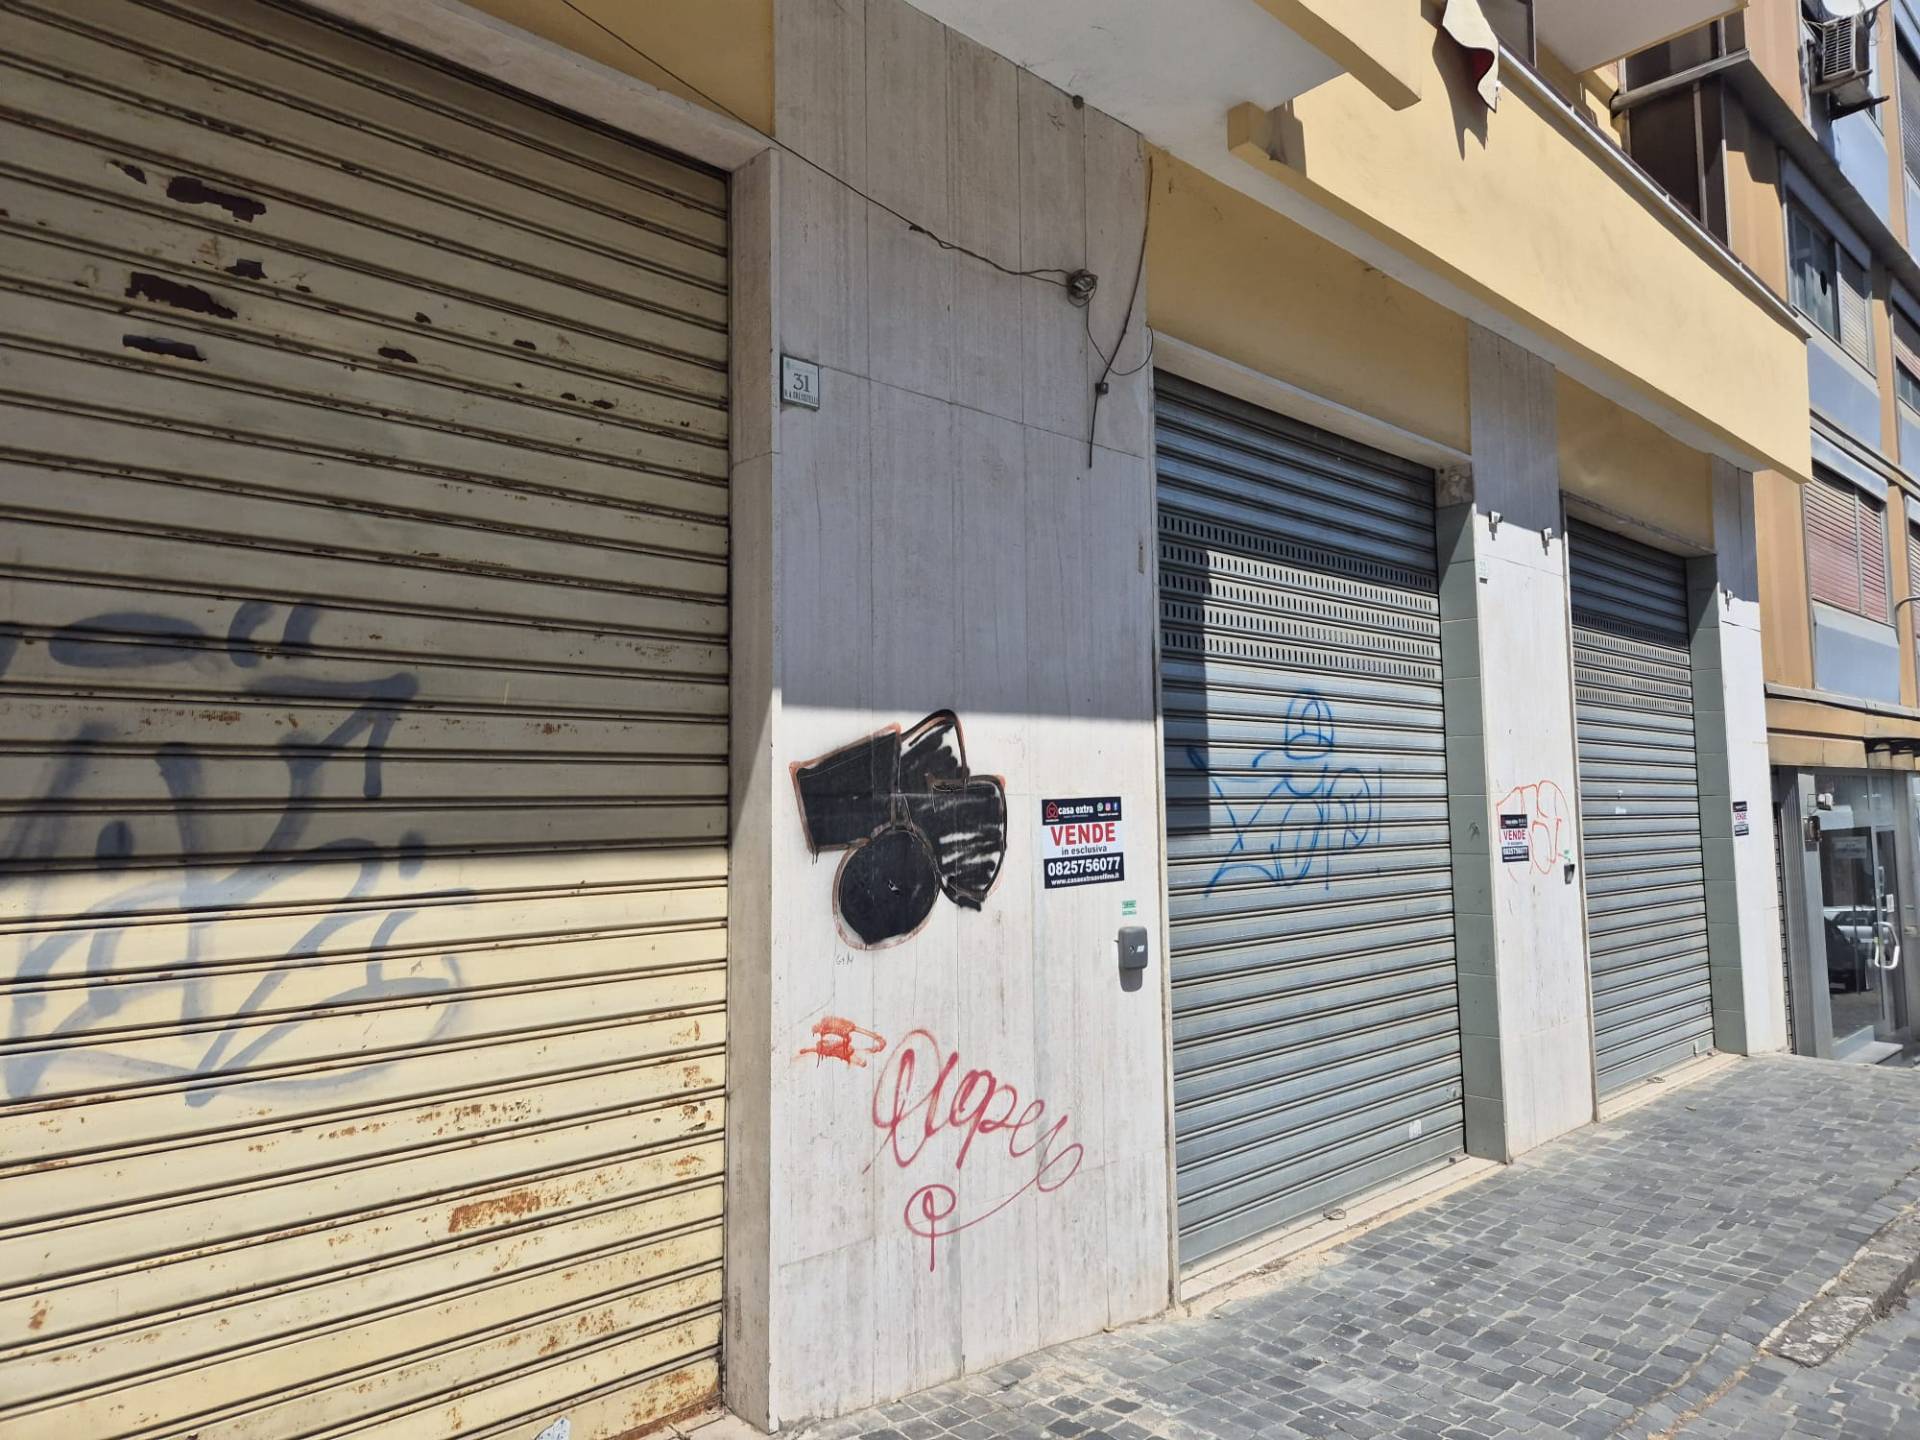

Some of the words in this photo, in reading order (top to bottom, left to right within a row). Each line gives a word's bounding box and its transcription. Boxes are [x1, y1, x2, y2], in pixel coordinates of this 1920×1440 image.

[793, 373, 810, 393] 31
[1058, 807, 1074, 815] casa
[1075, 804, 1094, 814] extra
[1050, 822, 1116, 847] VENDE
[1503, 829, 1526, 840] VENDE
[1062, 847, 1069, 855] in
[1071, 845, 1107, 855] esclusiva
[1047, 856, 1120, 876] 0825756077
